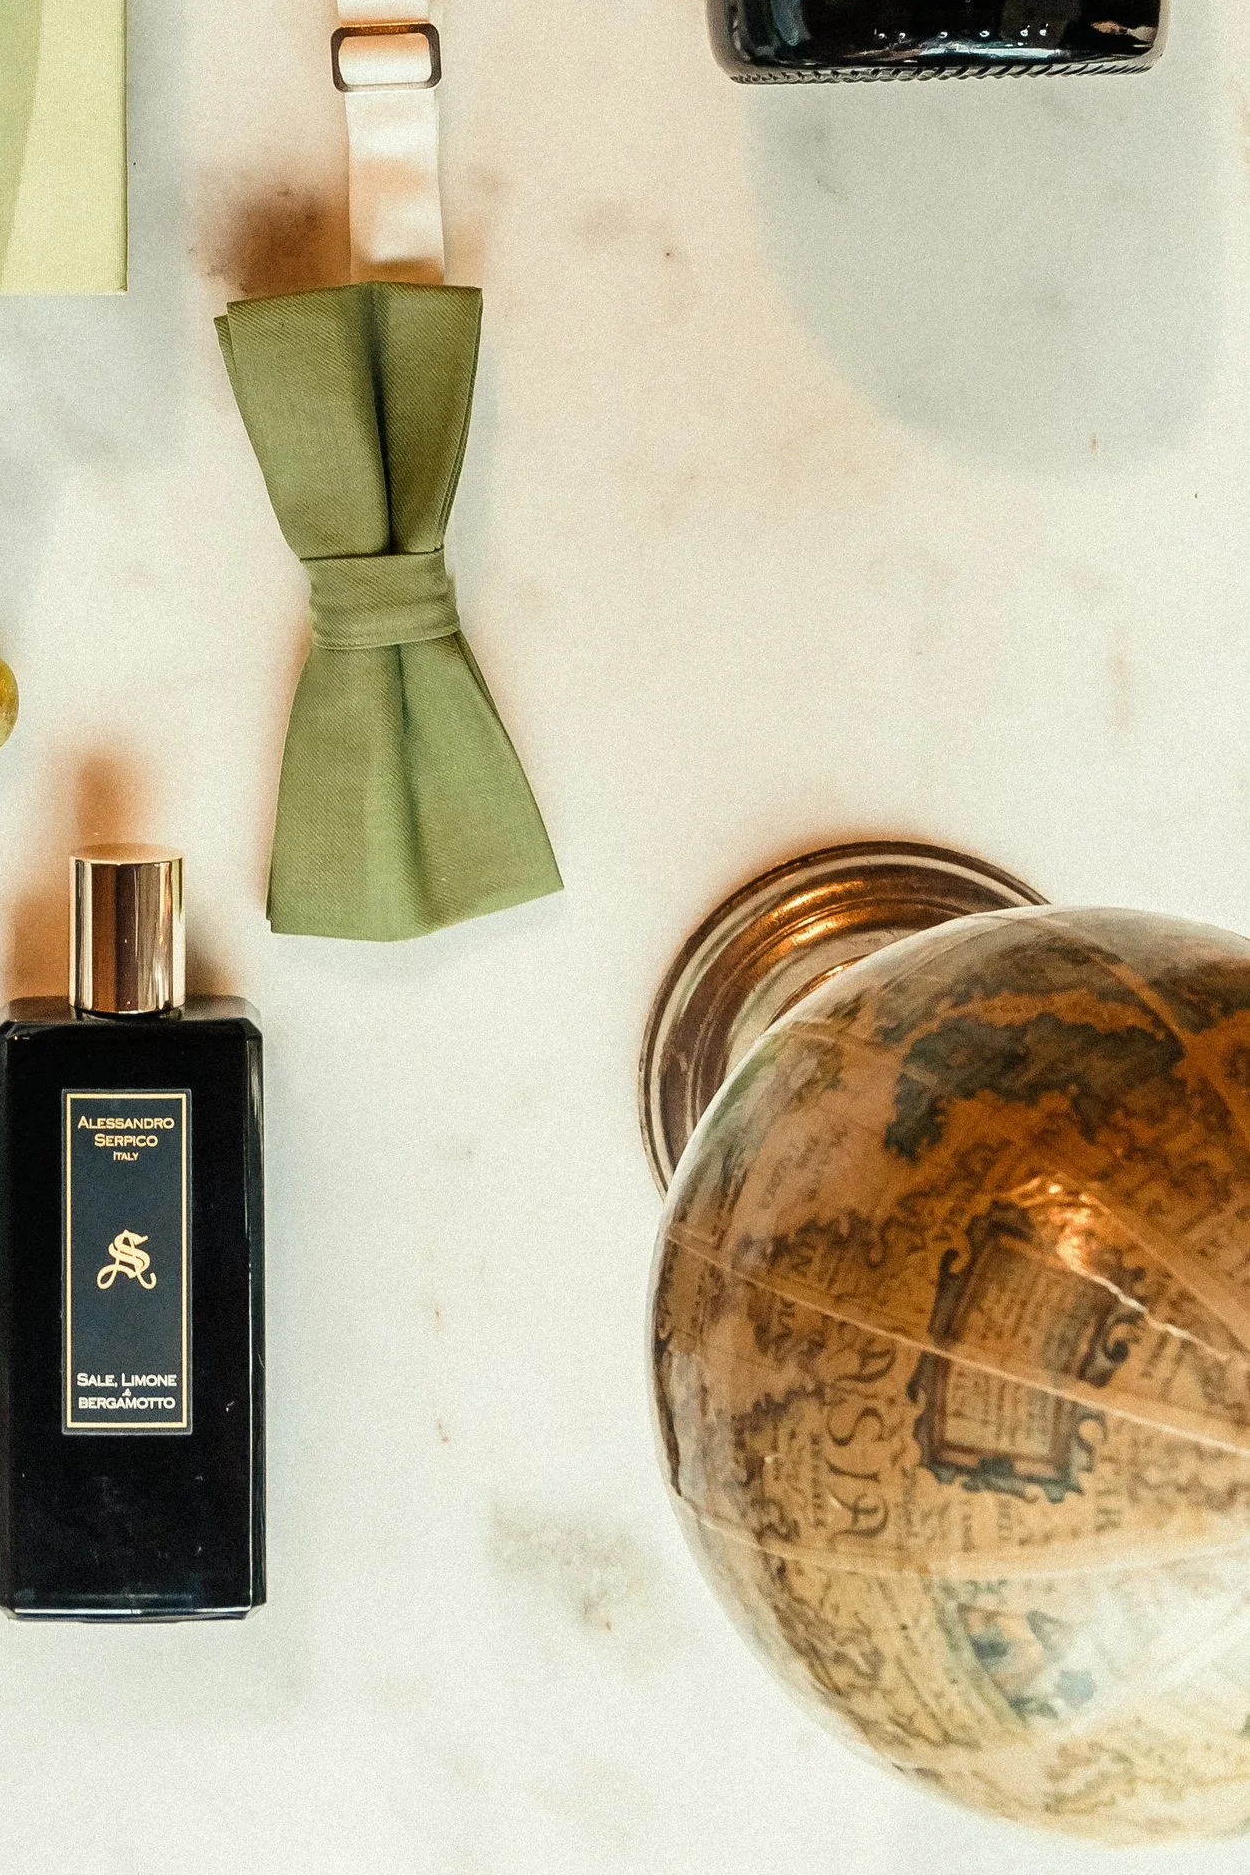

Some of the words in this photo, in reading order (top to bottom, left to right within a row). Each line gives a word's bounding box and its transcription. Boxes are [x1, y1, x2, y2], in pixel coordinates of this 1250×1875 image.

[77, 1115, 175, 1129] ALESSANDRO
[94, 1133, 159, 1147] SERPICO
[112, 1150, 139, 1161] ITALY
[76, 1372, 118, 1388] SALE,
[121, 1372, 178, 1387] LIMONE
[78, 1396, 176, 1410] BERGAMOTTO
